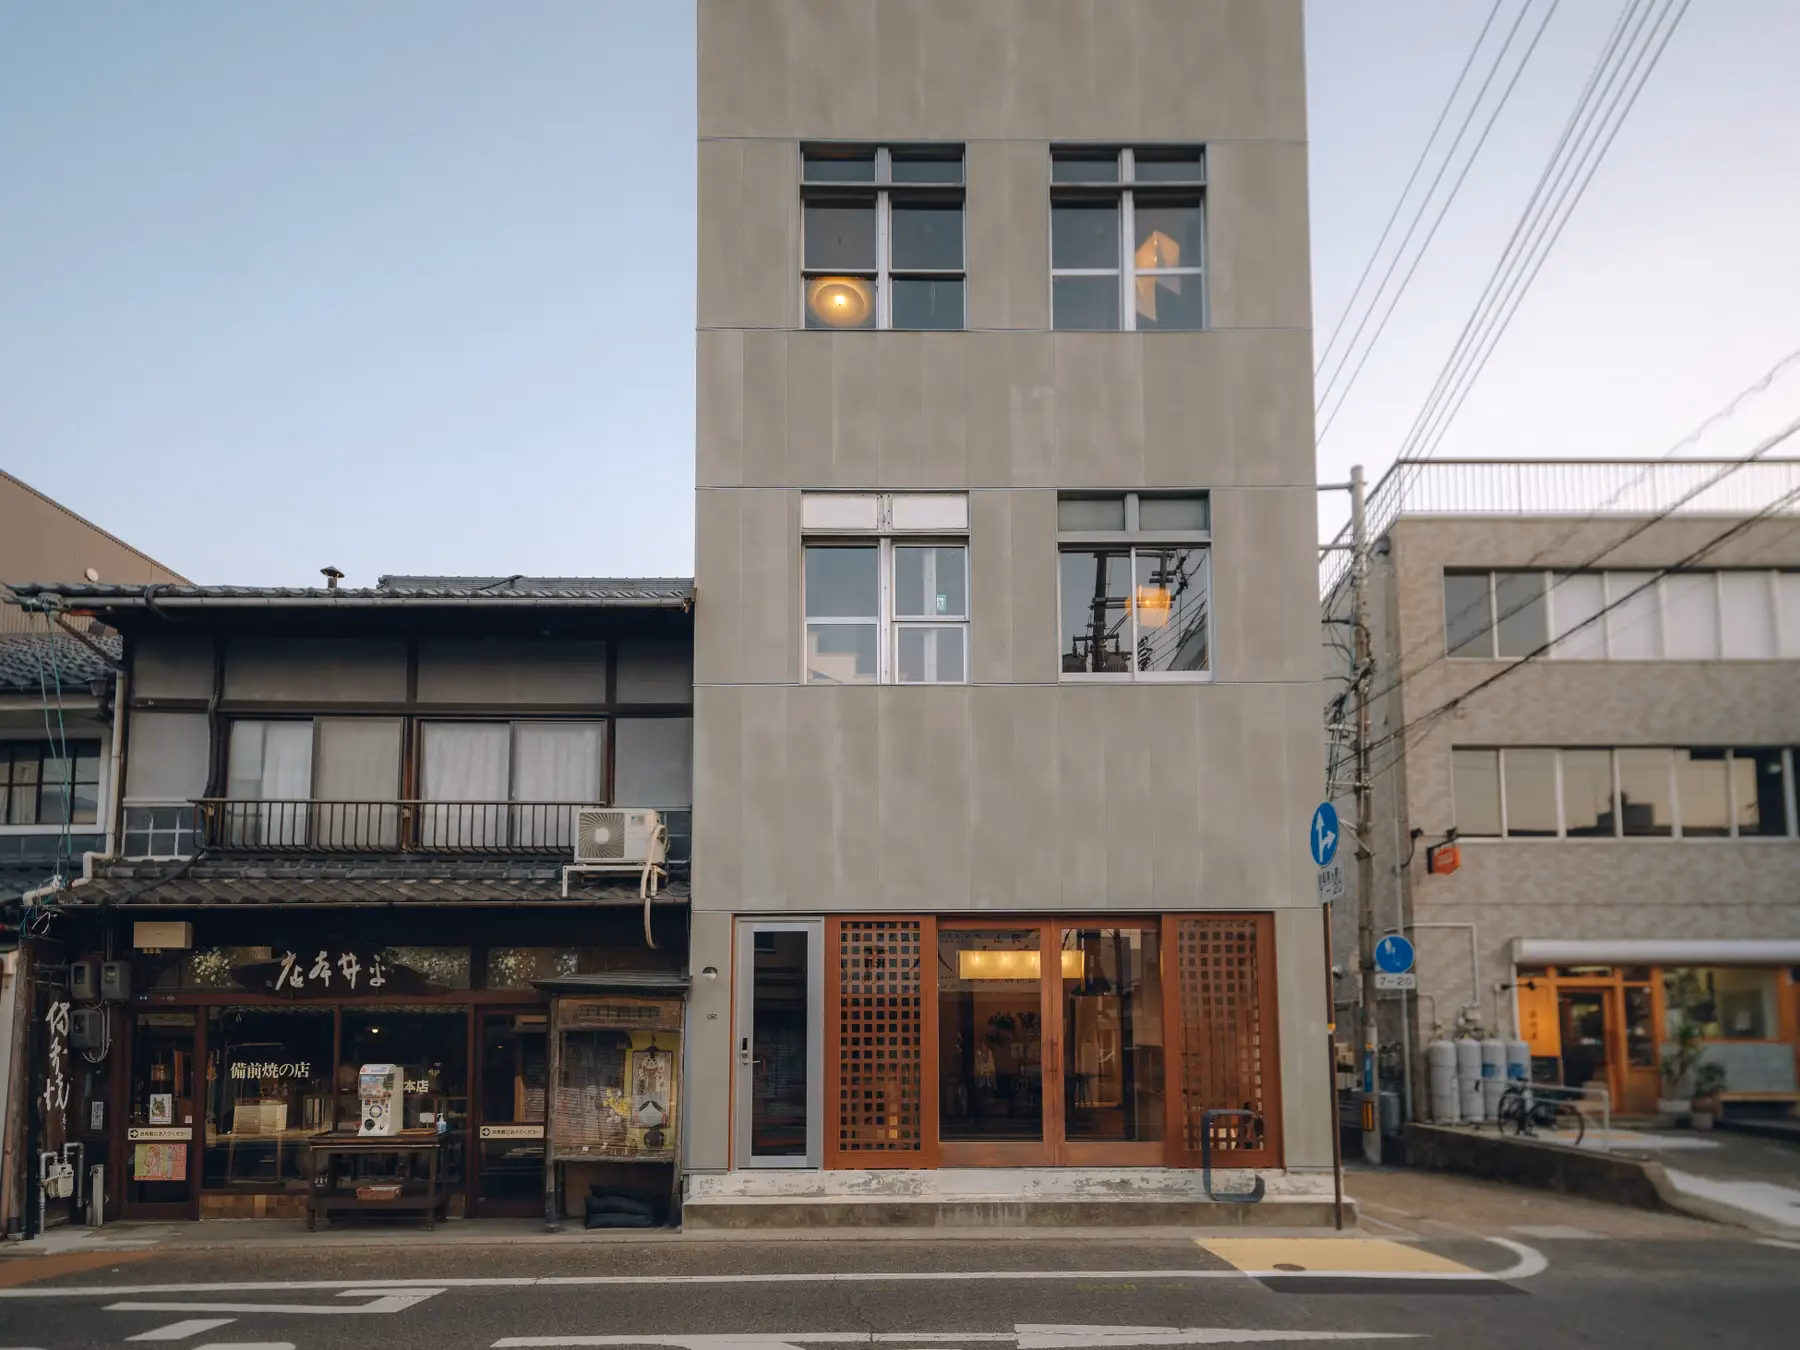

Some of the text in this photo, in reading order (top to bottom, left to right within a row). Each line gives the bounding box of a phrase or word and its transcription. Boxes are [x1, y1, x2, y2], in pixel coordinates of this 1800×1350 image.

[230, 1061, 311, 1080] 備前焼の店
[139, 1129, 190, 1138] お気軽にお入りください
